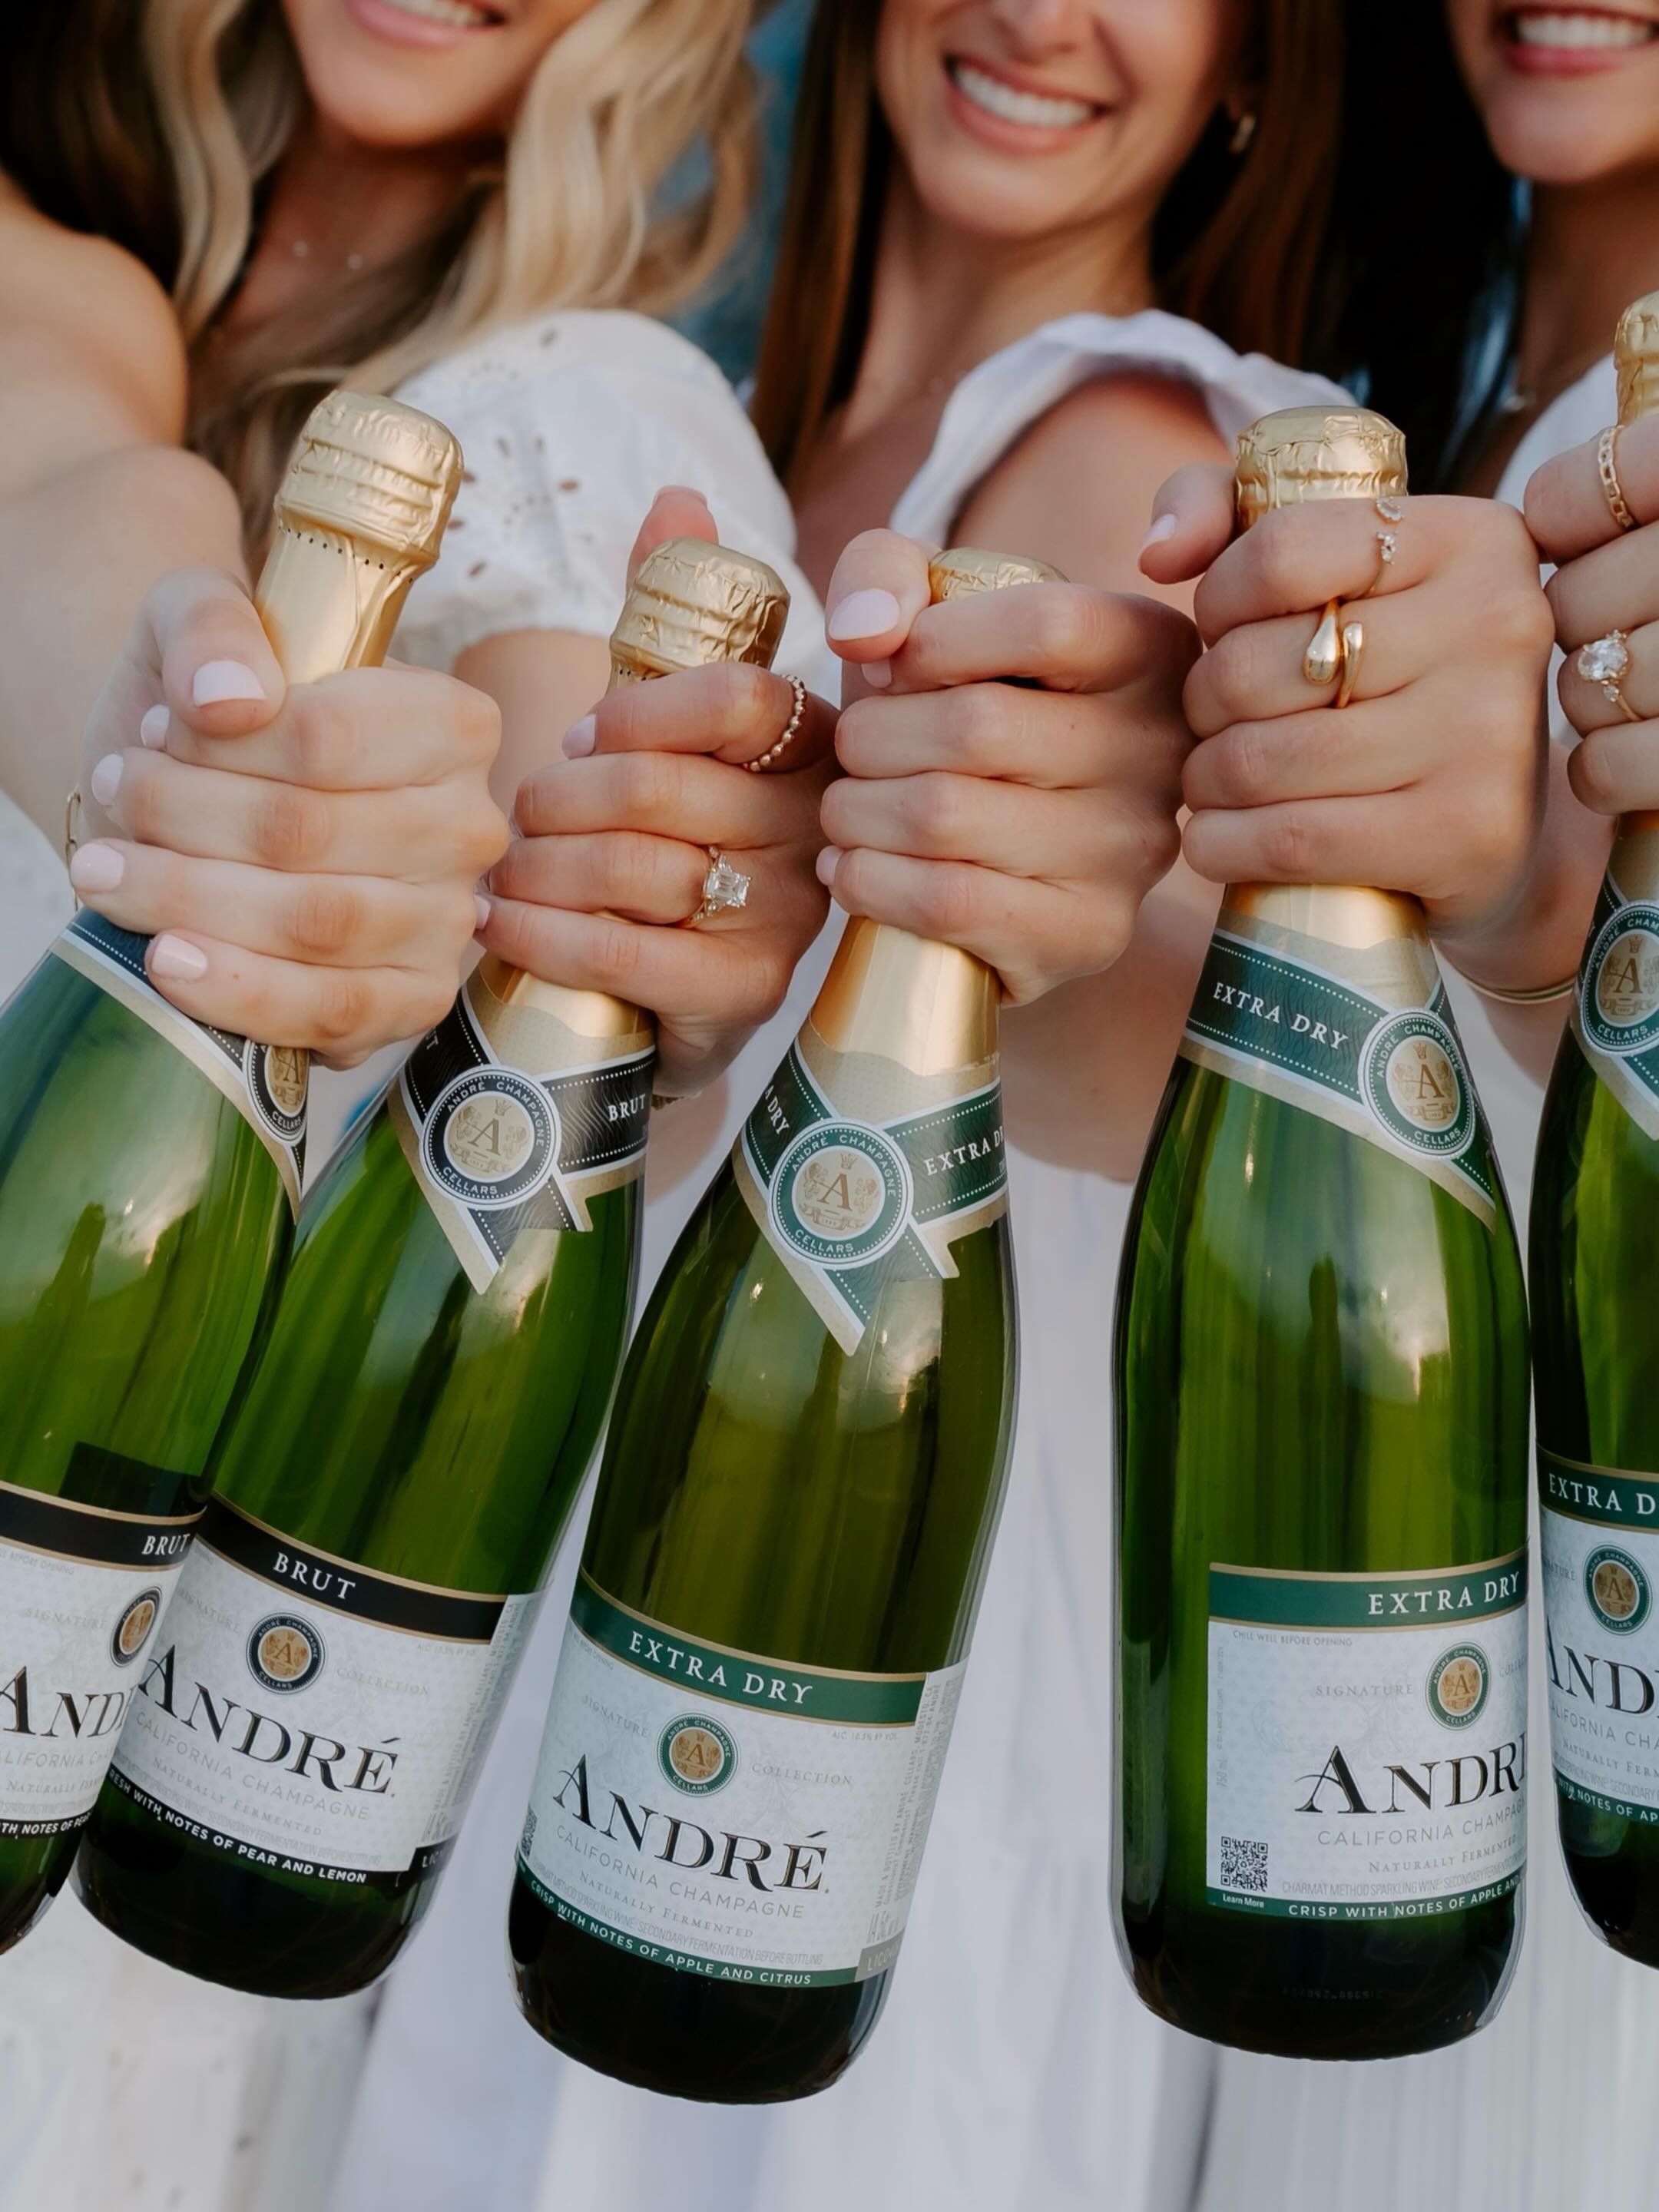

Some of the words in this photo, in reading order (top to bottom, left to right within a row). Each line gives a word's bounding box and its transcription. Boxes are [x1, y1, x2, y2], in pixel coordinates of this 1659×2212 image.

[1213, 982, 1281, 1024] EXTRA
[1290, 1013, 1349, 1050] DRY
[1597, 1023, 1649, 1041] CELLARS
[1404, 1024, 1461, 1071] CHAMPAGNE
[272, 1110, 302, 1131] CELLARS
[447, 1081, 486, 1113] ANDRÉ
[496, 1081, 545, 1147] CHAMPAGNE
[608, 1093, 646, 1122] BRUT
[767, 1095, 790, 1134] DRY
[1413, 1127, 1462, 1146] CELLARS
[792, 1135, 830, 1172] ANDRÉ
[839, 1134, 896, 1197] CHAMPAGNE
[923, 1137, 992, 1177] EXTRA
[442, 1166, 498, 1195] CELLARS
[795, 1229, 855, 1253] CELLARS
[1548, 1472, 1623, 1512] EXTRA
[141, 1533, 190, 1556] BRUT
[273, 1551, 356, 1600] BRUT
[1368, 1586, 1474, 1615] EXTRA
[1484, 1571, 1520, 1604] DRY
[1280, 1634, 1311, 1646] BEFORE
[1313, 1636, 1353, 1647] OPENING
[628, 1631, 727, 1687] EXTRA
[742, 1672, 813, 1704] DRY
[1315, 1683, 1414, 1697] SIGNATURE
[582, 1694, 649, 1739] SIGNATURE
[136, 1710, 233, 1780] CALIFORNIA
[242, 1774, 370, 1820] CHAMPAGNE
[751, 1761, 853, 1786] COLLECTION
[154, 1757, 224, 1805] NATURALLY
[232, 1798, 323, 1836] FERMENTED
[1578, 1789, 1611, 1812] NOTES
[1616, 1803, 1634, 1817] OF
[21, 1822, 59, 1836] NOTES
[60, 1820, 75, 1832] OF
[133, 1789, 162, 1815] WITH
[164, 1810, 209, 1840] NOTES
[213, 1834, 234, 1850] OF
[237, 1843, 278, 1867] PEAR
[282, 1859, 314, 1876] AND
[318, 1866, 367, 1884] LEMON
[552, 1753, 828, 1892] ANDRÉ
[1316, 1824, 1454, 1846] CALIFORNIA
[556, 1824, 658, 1889] CALIFORNIA
[669, 1881, 805, 1919] CHAMPAGNE
[1368, 1856, 1455, 1873] NATURALLY
[579, 1871, 656, 1914] NATURALLY
[663, 1907, 753, 1938] FERMENTED
[1222, 1893, 1243, 1906] Learn
[1243, 1897, 1265, 1909] More
[1282, 1881, 1329, 1896] CHARMAT
[1329, 1883, 1369, 1896] METHOD
[1288, 1904, 1338, 1917] CRISP
[1345, 1906, 1387, 1918] WITH
[1394, 1901, 1443, 1917] NOTES
[1449, 1896, 1465, 1909] OF
[1470, 1883, 1502, 1905] APPLE
[531, 1879, 555, 1904] CRISP
[558, 1902, 586, 1927] WITH
[589, 1922, 633, 1950] NOTES
[639, 1944, 660, 1958] OF
[665, 1953, 715, 1974] APPLE
[720, 1966, 753, 1980] AND
[760, 1972, 812, 1985] CITRUS
